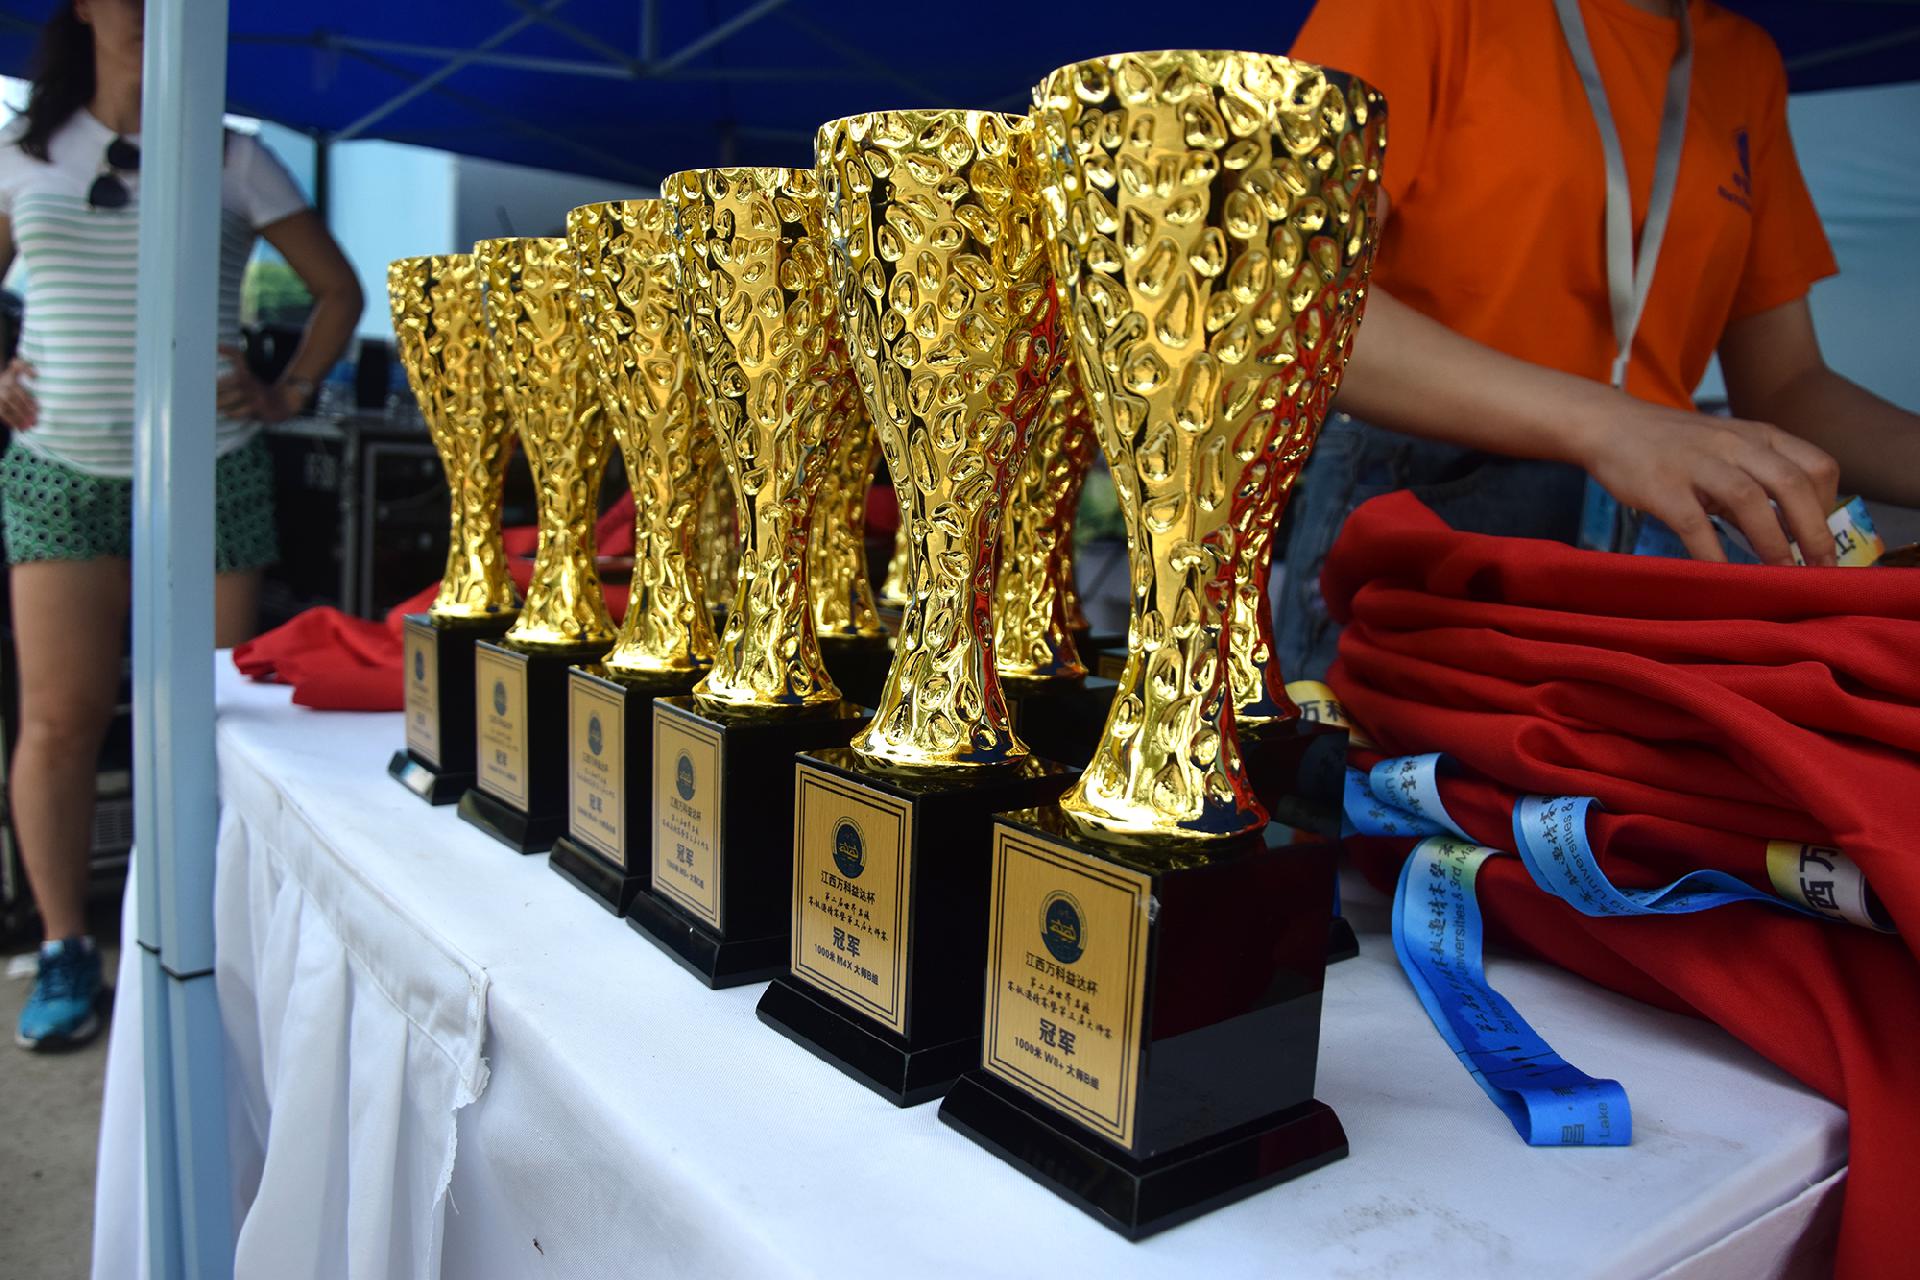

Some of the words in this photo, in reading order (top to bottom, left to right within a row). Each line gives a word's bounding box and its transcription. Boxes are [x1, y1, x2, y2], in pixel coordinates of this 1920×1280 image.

[1563, 814, 1607, 900] Universities
[821, 870, 876, 905] 江西万科益达杯
[1450, 866, 1462, 891] 3rd
[833, 926, 860, 957] 冠军
[1025, 951, 1098, 996] 江西万科益达杯
[1039, 1017, 1076, 1056] 冠军
[1598, 1103, 1610, 1138] Lake
